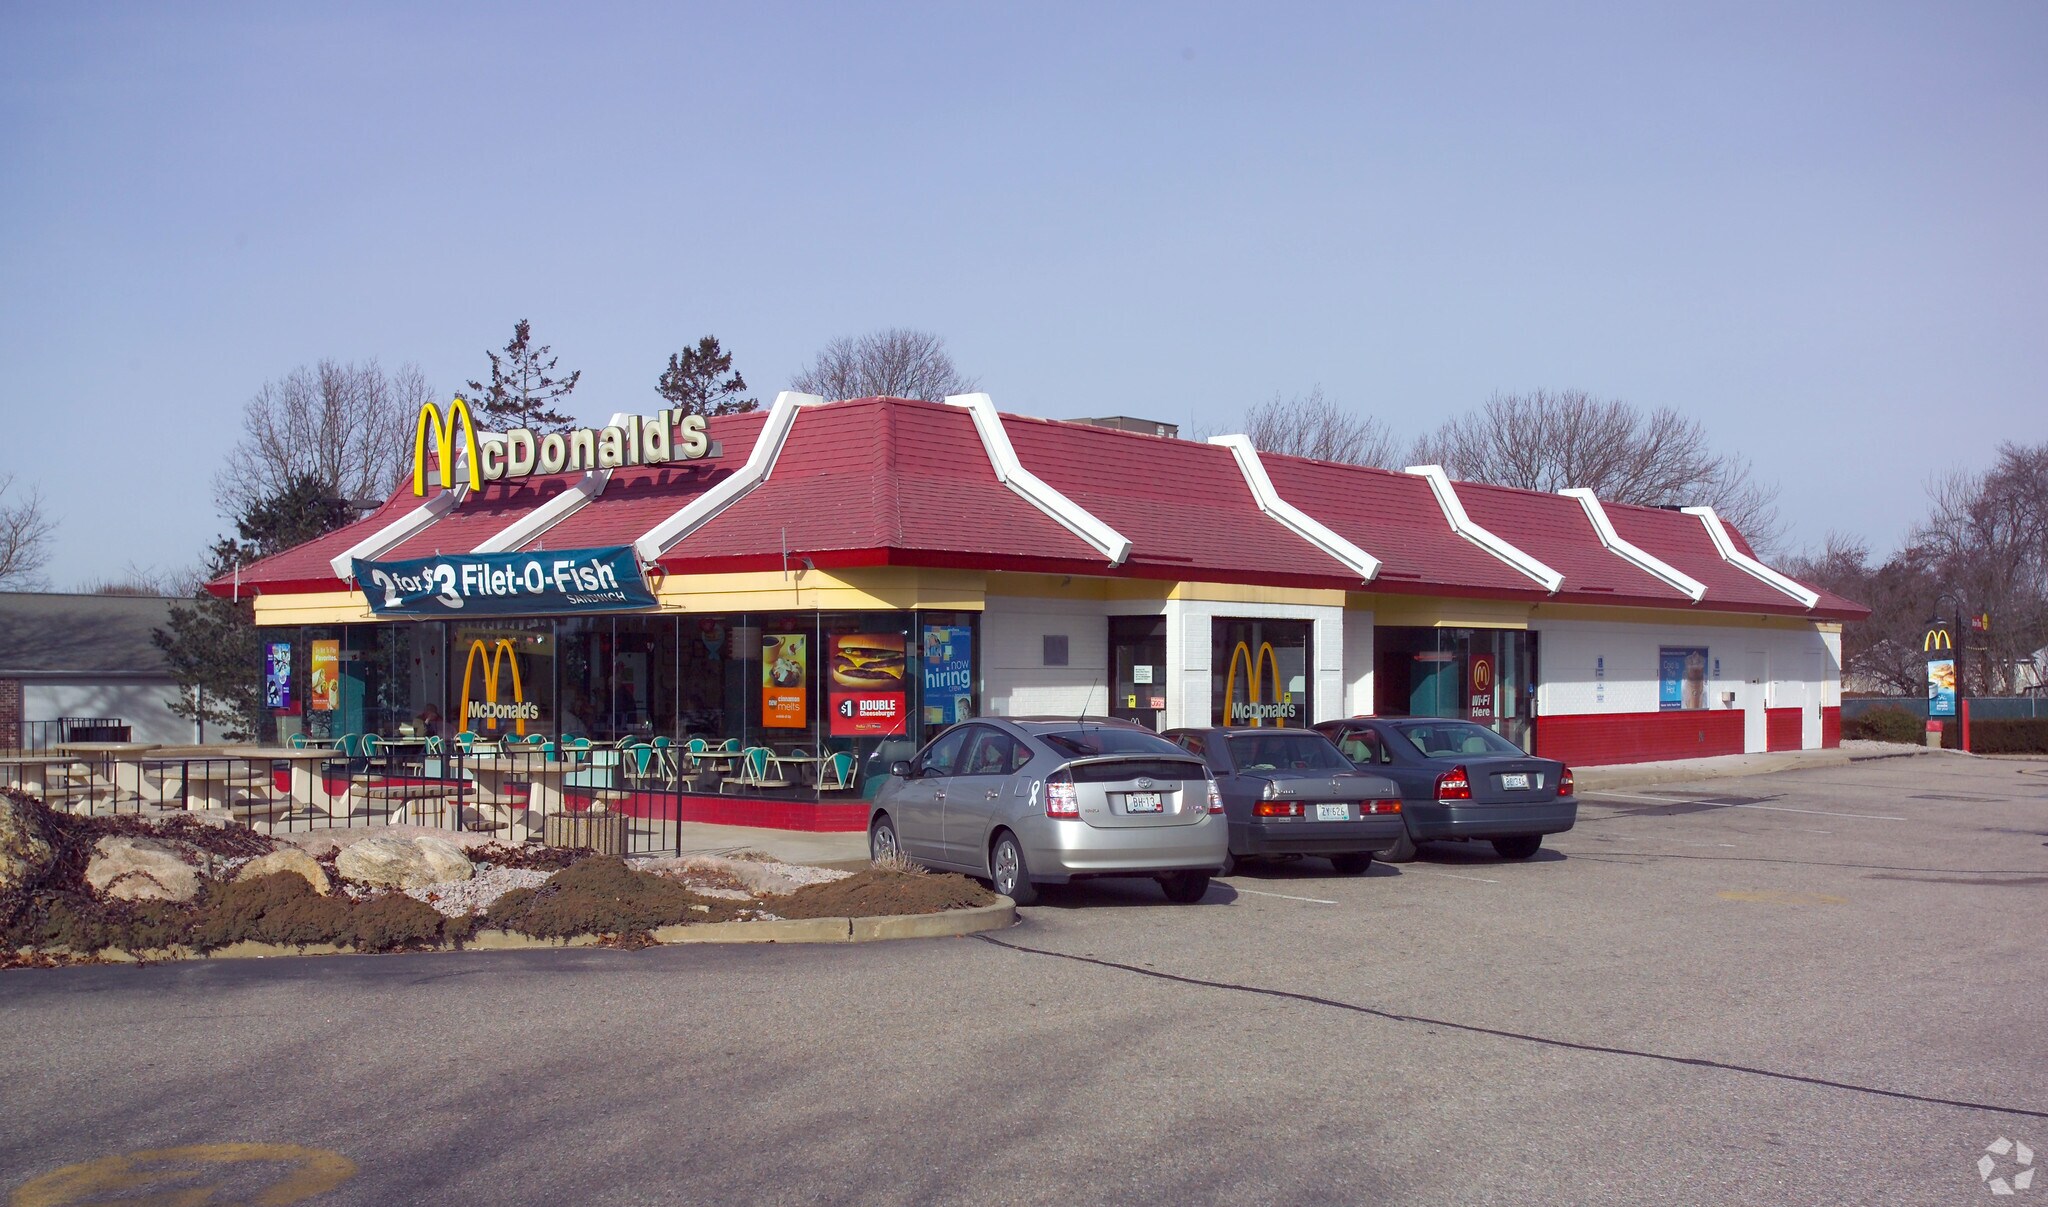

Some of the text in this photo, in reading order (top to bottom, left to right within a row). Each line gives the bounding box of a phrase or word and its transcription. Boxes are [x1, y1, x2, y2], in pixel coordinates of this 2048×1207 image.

[413, 398, 710, 496] McDonald's
[393, 572, 423, 593] for
[461, 558, 620, 597] Filet-O-Fish
[566, 591, 627, 605] SANDWICH
[951, 661, 969, 670] now
[925, 666, 971, 688] hiring
[468, 701, 539, 719] McDonald's
[778, 702, 800, 711] melts
[840, 700, 852, 717] $1
[860, 700, 896, 710] DOUBLE
[1231, 702, 1296, 719] McDonald's
[1472, 707, 1490, 717] Here
[860, 710, 896, 718] Cheeseburger
